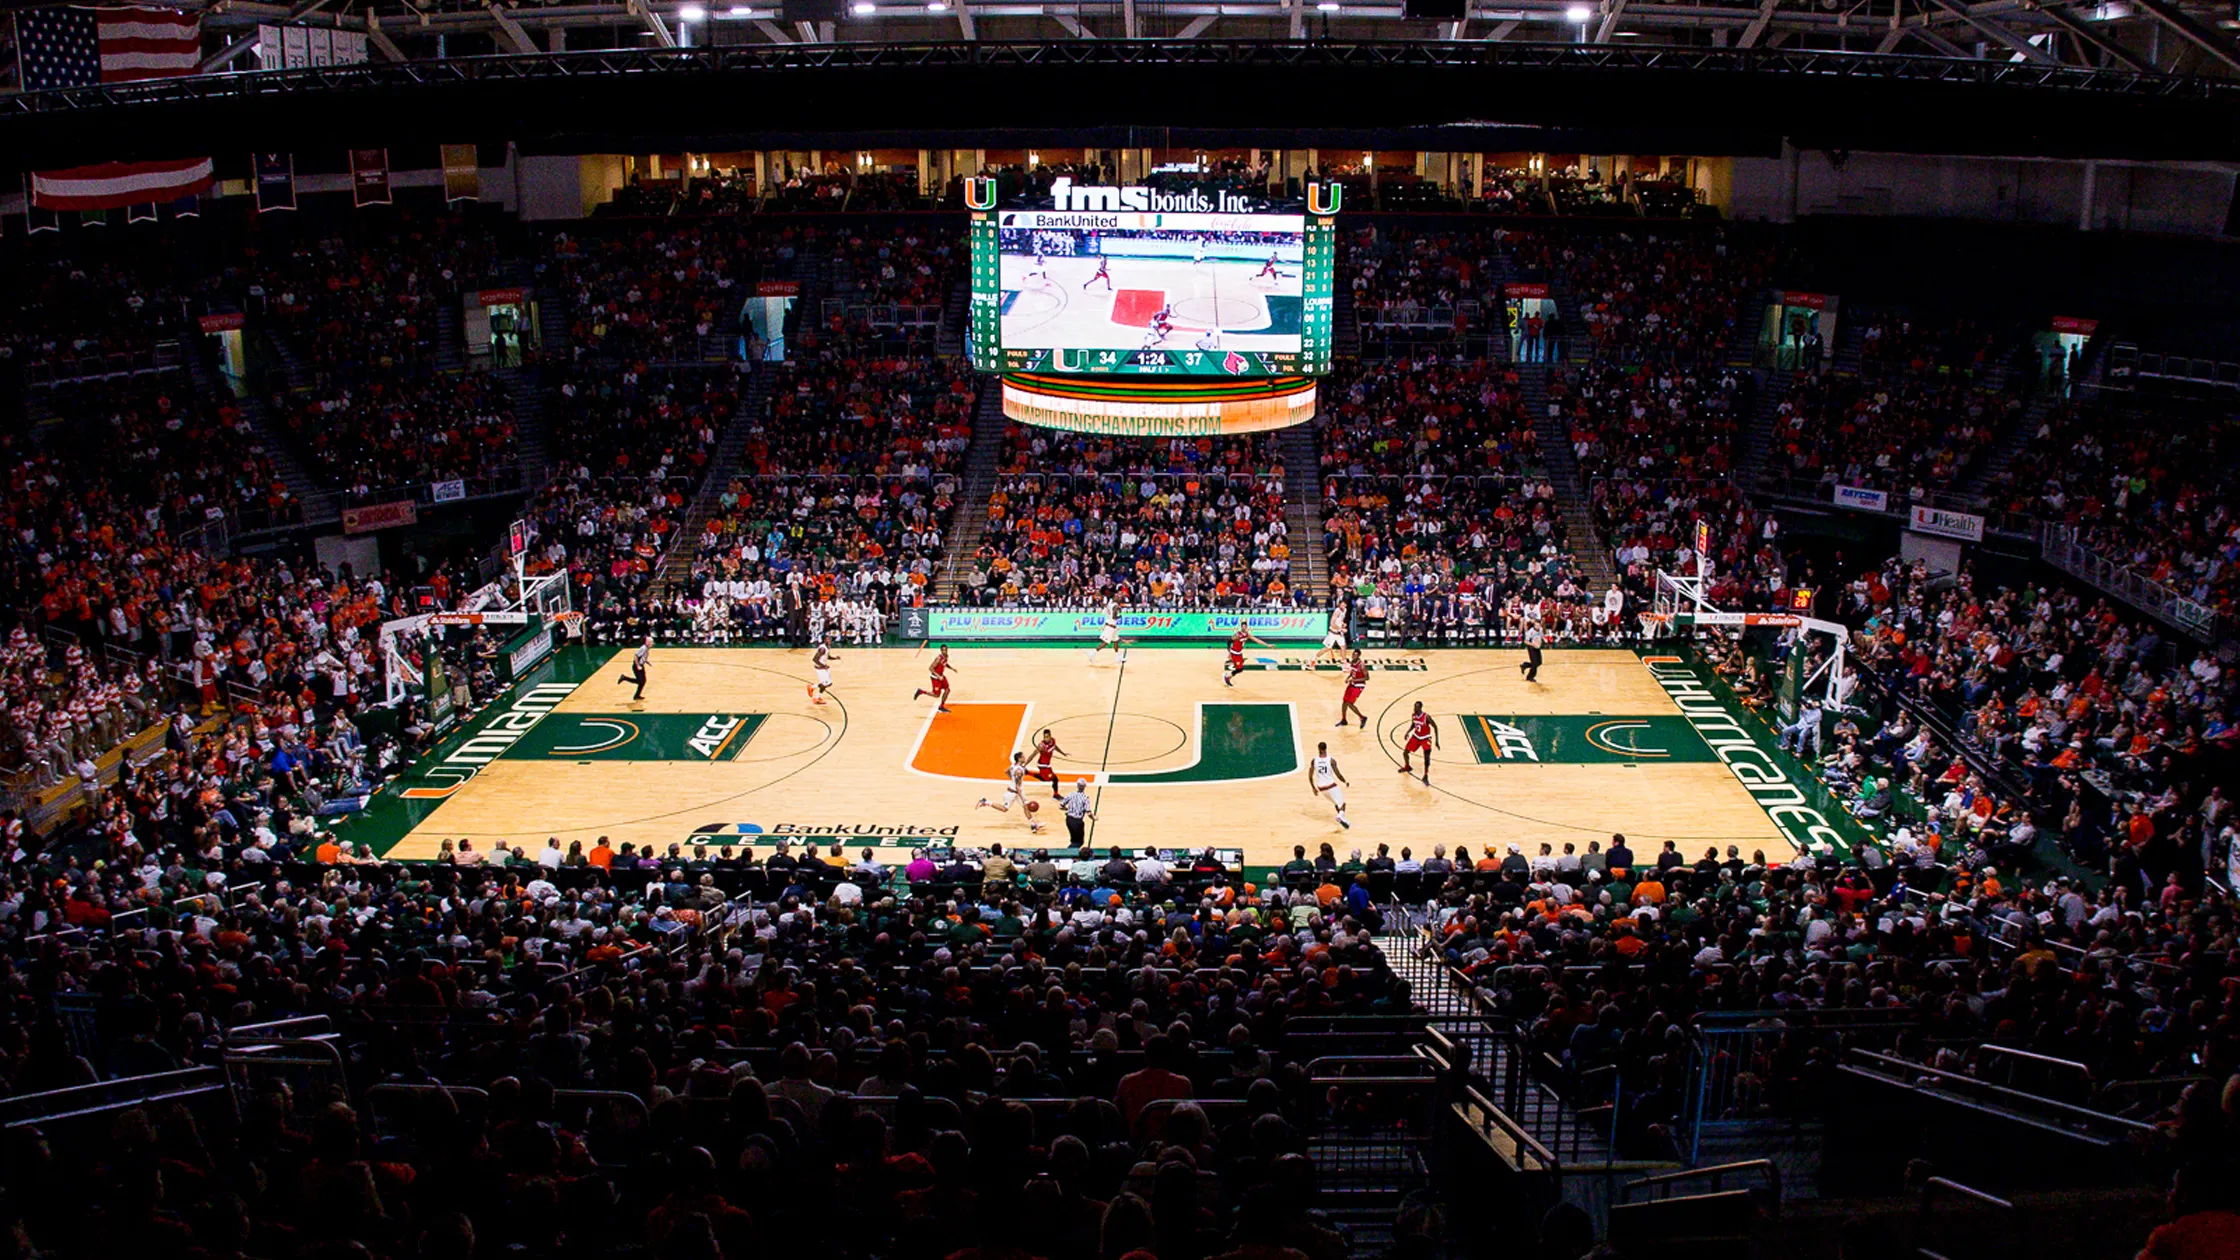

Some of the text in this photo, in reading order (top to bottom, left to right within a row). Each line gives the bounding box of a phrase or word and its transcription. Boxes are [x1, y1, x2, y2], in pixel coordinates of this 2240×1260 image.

[1217, 190, 1254, 213] Inc.
[1036, 215, 1118, 228] BankUnited
[1303, 338, 1314, 347] 22
[988, 347, 998, 356] 10
[1034, 350, 1041, 358] 3
[1261, 353, 1268, 362] 7
[1303, 351, 1314, 360] 32
[1099, 351, 1117, 365] 34
[1137, 352, 1166, 365] 1:24
[1185, 352, 1203, 366] 37
[1270, 364, 1277, 373] 3
[688, 715, 741, 757] ACC
[1487, 718, 1540, 762] ACC
[1318, 765, 1327, 774] 21
[771, 823, 960, 835] BankUnited
[690, 834, 949, 847] CENTER
